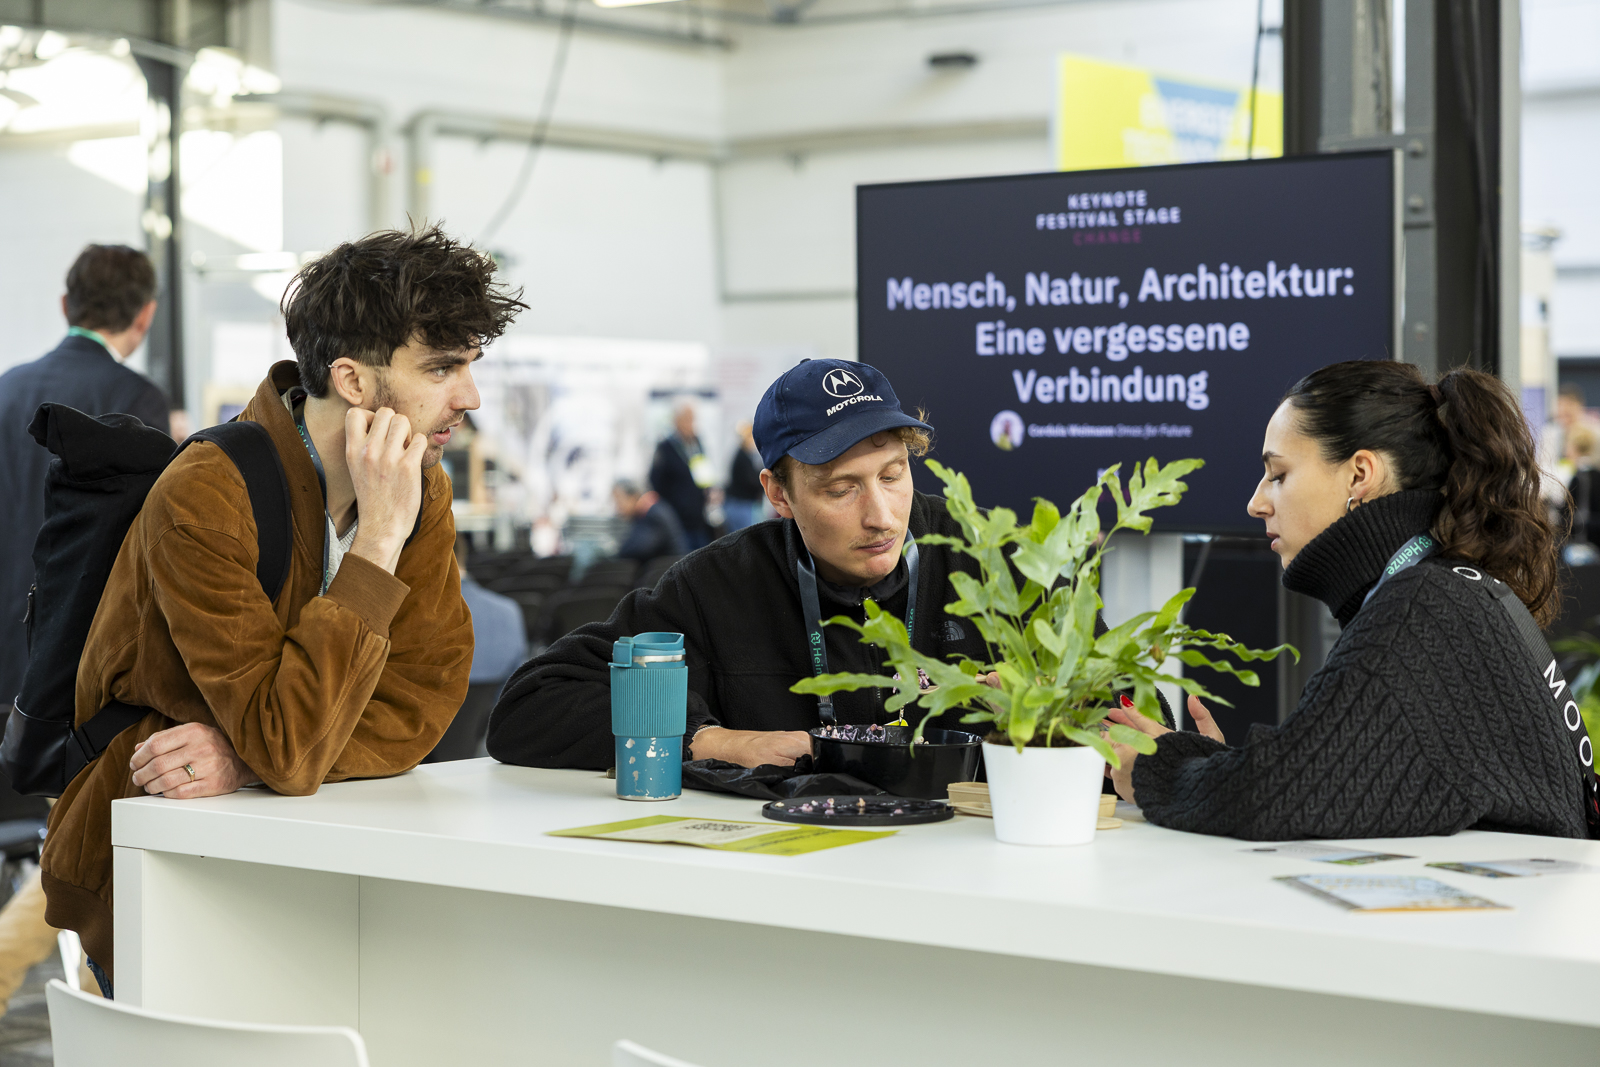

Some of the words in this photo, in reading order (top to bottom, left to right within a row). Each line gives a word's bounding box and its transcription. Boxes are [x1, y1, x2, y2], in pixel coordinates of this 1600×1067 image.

[1067, 189, 1148, 210] KEYNOTE
[1036, 210, 1119, 230] FESTIVAL
[1123, 206, 1181, 226] STAGE
[1072, 228, 1142, 246] CHANGE
[886, 271, 1017, 312] Mensch,
[1025, 271, 1130, 308] Natur,
[1137, 260, 1354, 302] Architektur:
[976, 320, 1046, 355] Eine
[1053, 322, 1250, 361] vergessene
[1012, 366, 1210, 410] Verbindung
[826, 394, 884, 416] MOTOROLA
[1386, 541, 1423, 575] Heinze
[812, 647, 824, 677] Hein
[1543, 659, 1598, 792] MOO
